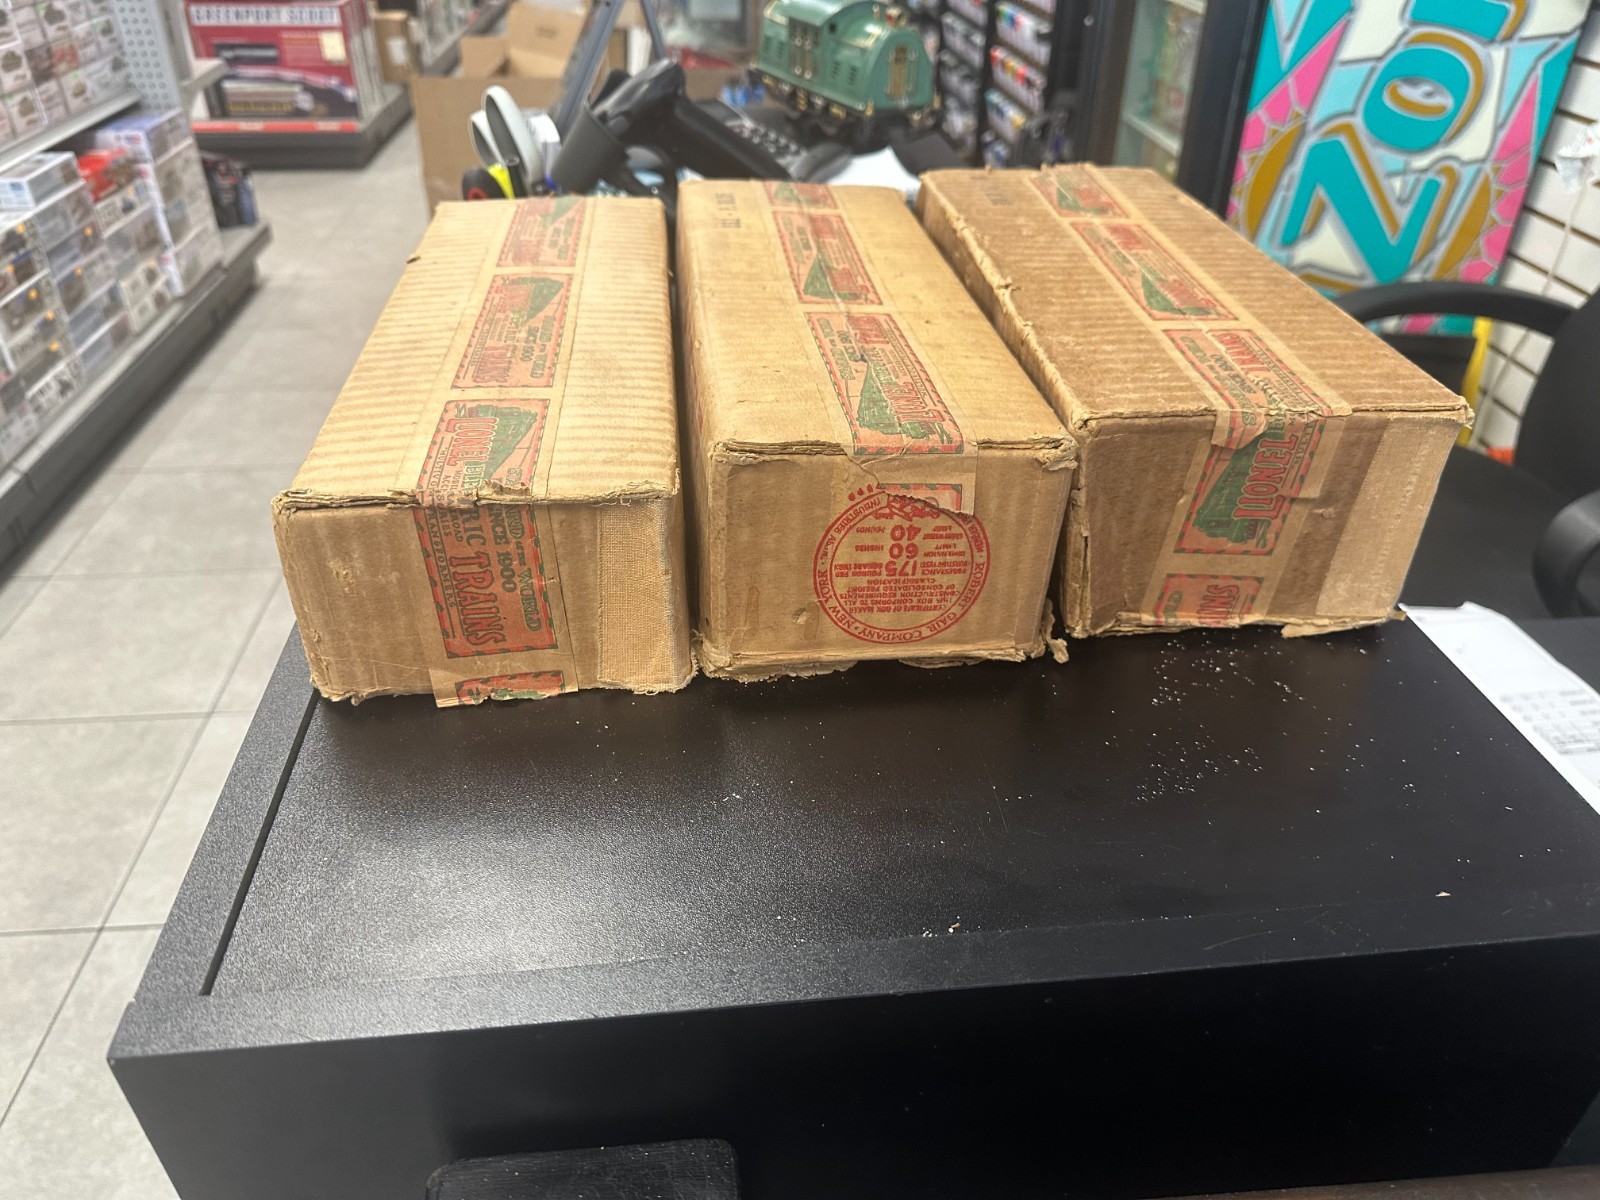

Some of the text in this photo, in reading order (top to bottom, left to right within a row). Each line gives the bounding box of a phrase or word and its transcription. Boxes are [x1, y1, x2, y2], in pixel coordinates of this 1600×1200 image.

[880, 381, 945, 422] LIONEL
[446, 417, 499, 467] LIONEL
[1232, 434, 1299, 520] LIONEL
[889, 543, 919, 559] 60
[890, 525, 921, 541] 40
[495, 551, 517, 592] 1900
[885, 561, 918, 576] 175
[449, 551, 507, 647] TRAINS
[517, 568, 541, 632] WORLD
[818, 561, 985, 641] ROBERT GAIR COMPANY NEW YORK
